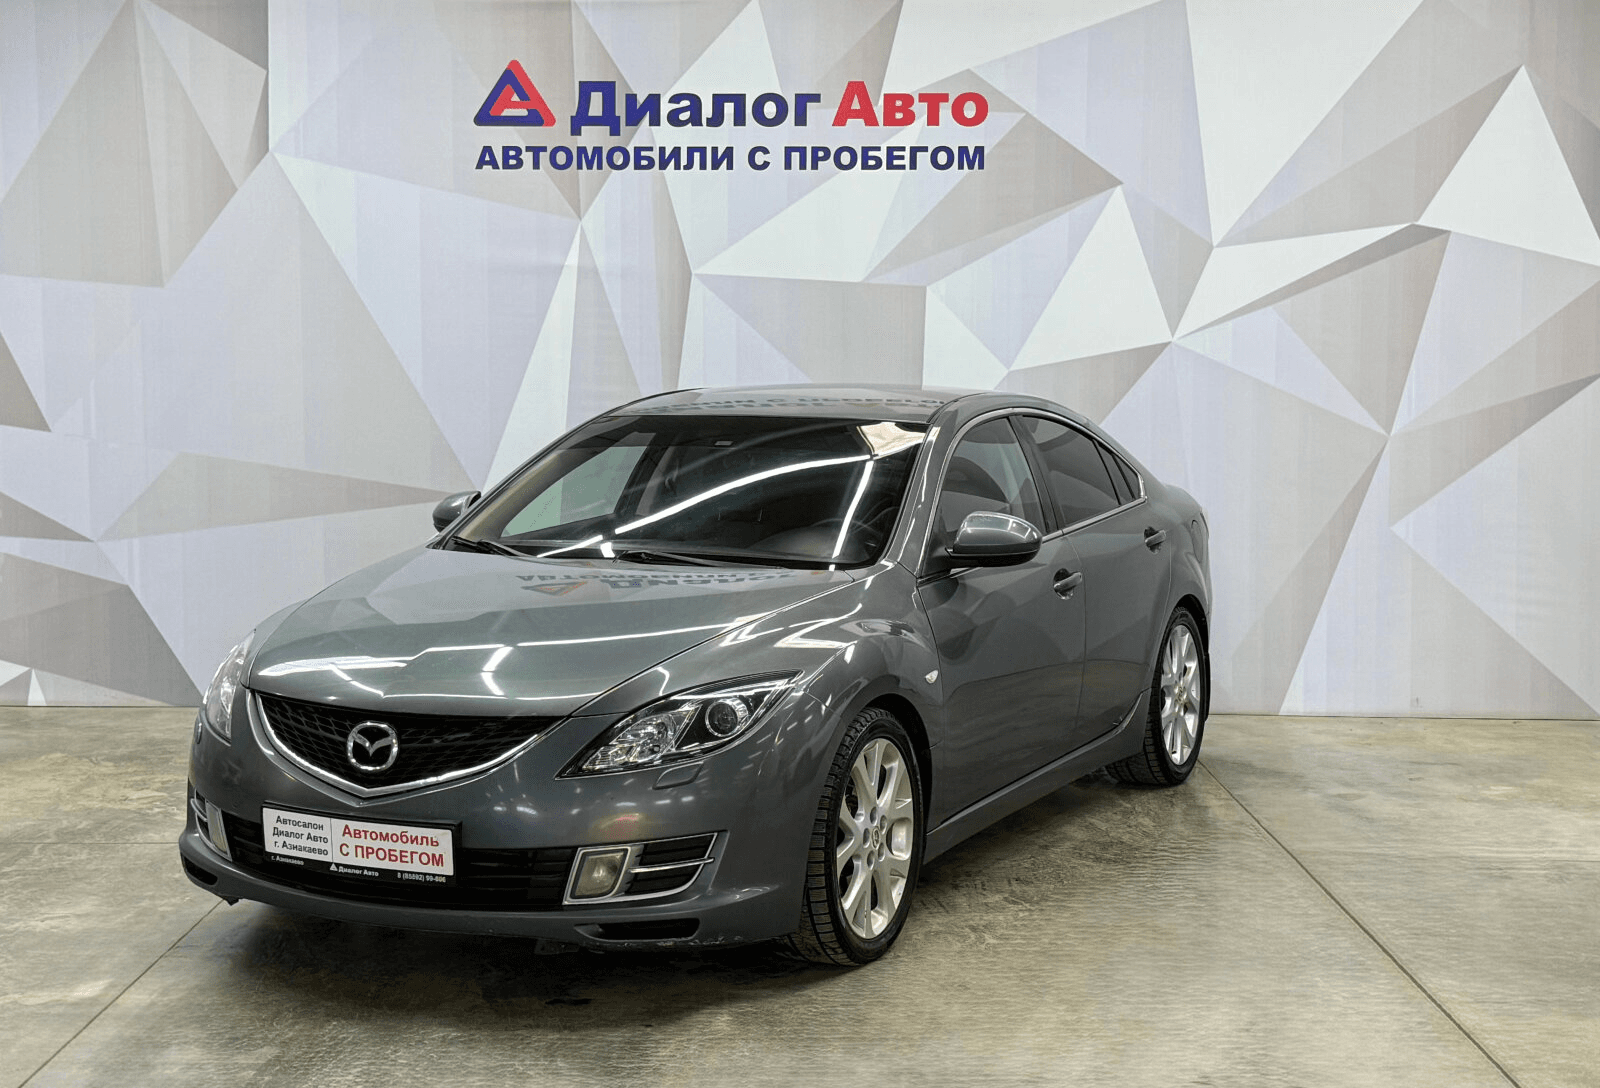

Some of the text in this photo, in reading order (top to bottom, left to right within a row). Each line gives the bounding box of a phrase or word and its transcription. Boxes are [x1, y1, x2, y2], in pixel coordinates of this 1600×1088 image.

[570, 80, 989, 136] Диалог Авто
[476, 145, 986, 171] АВТОМОБИЛИ С ПРОБЕГОМ
[276, 815, 324, 831] Автосалон
[272, 827, 329, 844] Диалог Авто
[342, 824, 440, 847] Автомобиль
[282, 841, 329, 856] Азнакаево
[339, 843, 444, 867] С ПРОБЕГОМ
[338, 866, 379, 877] Диалог Авто
